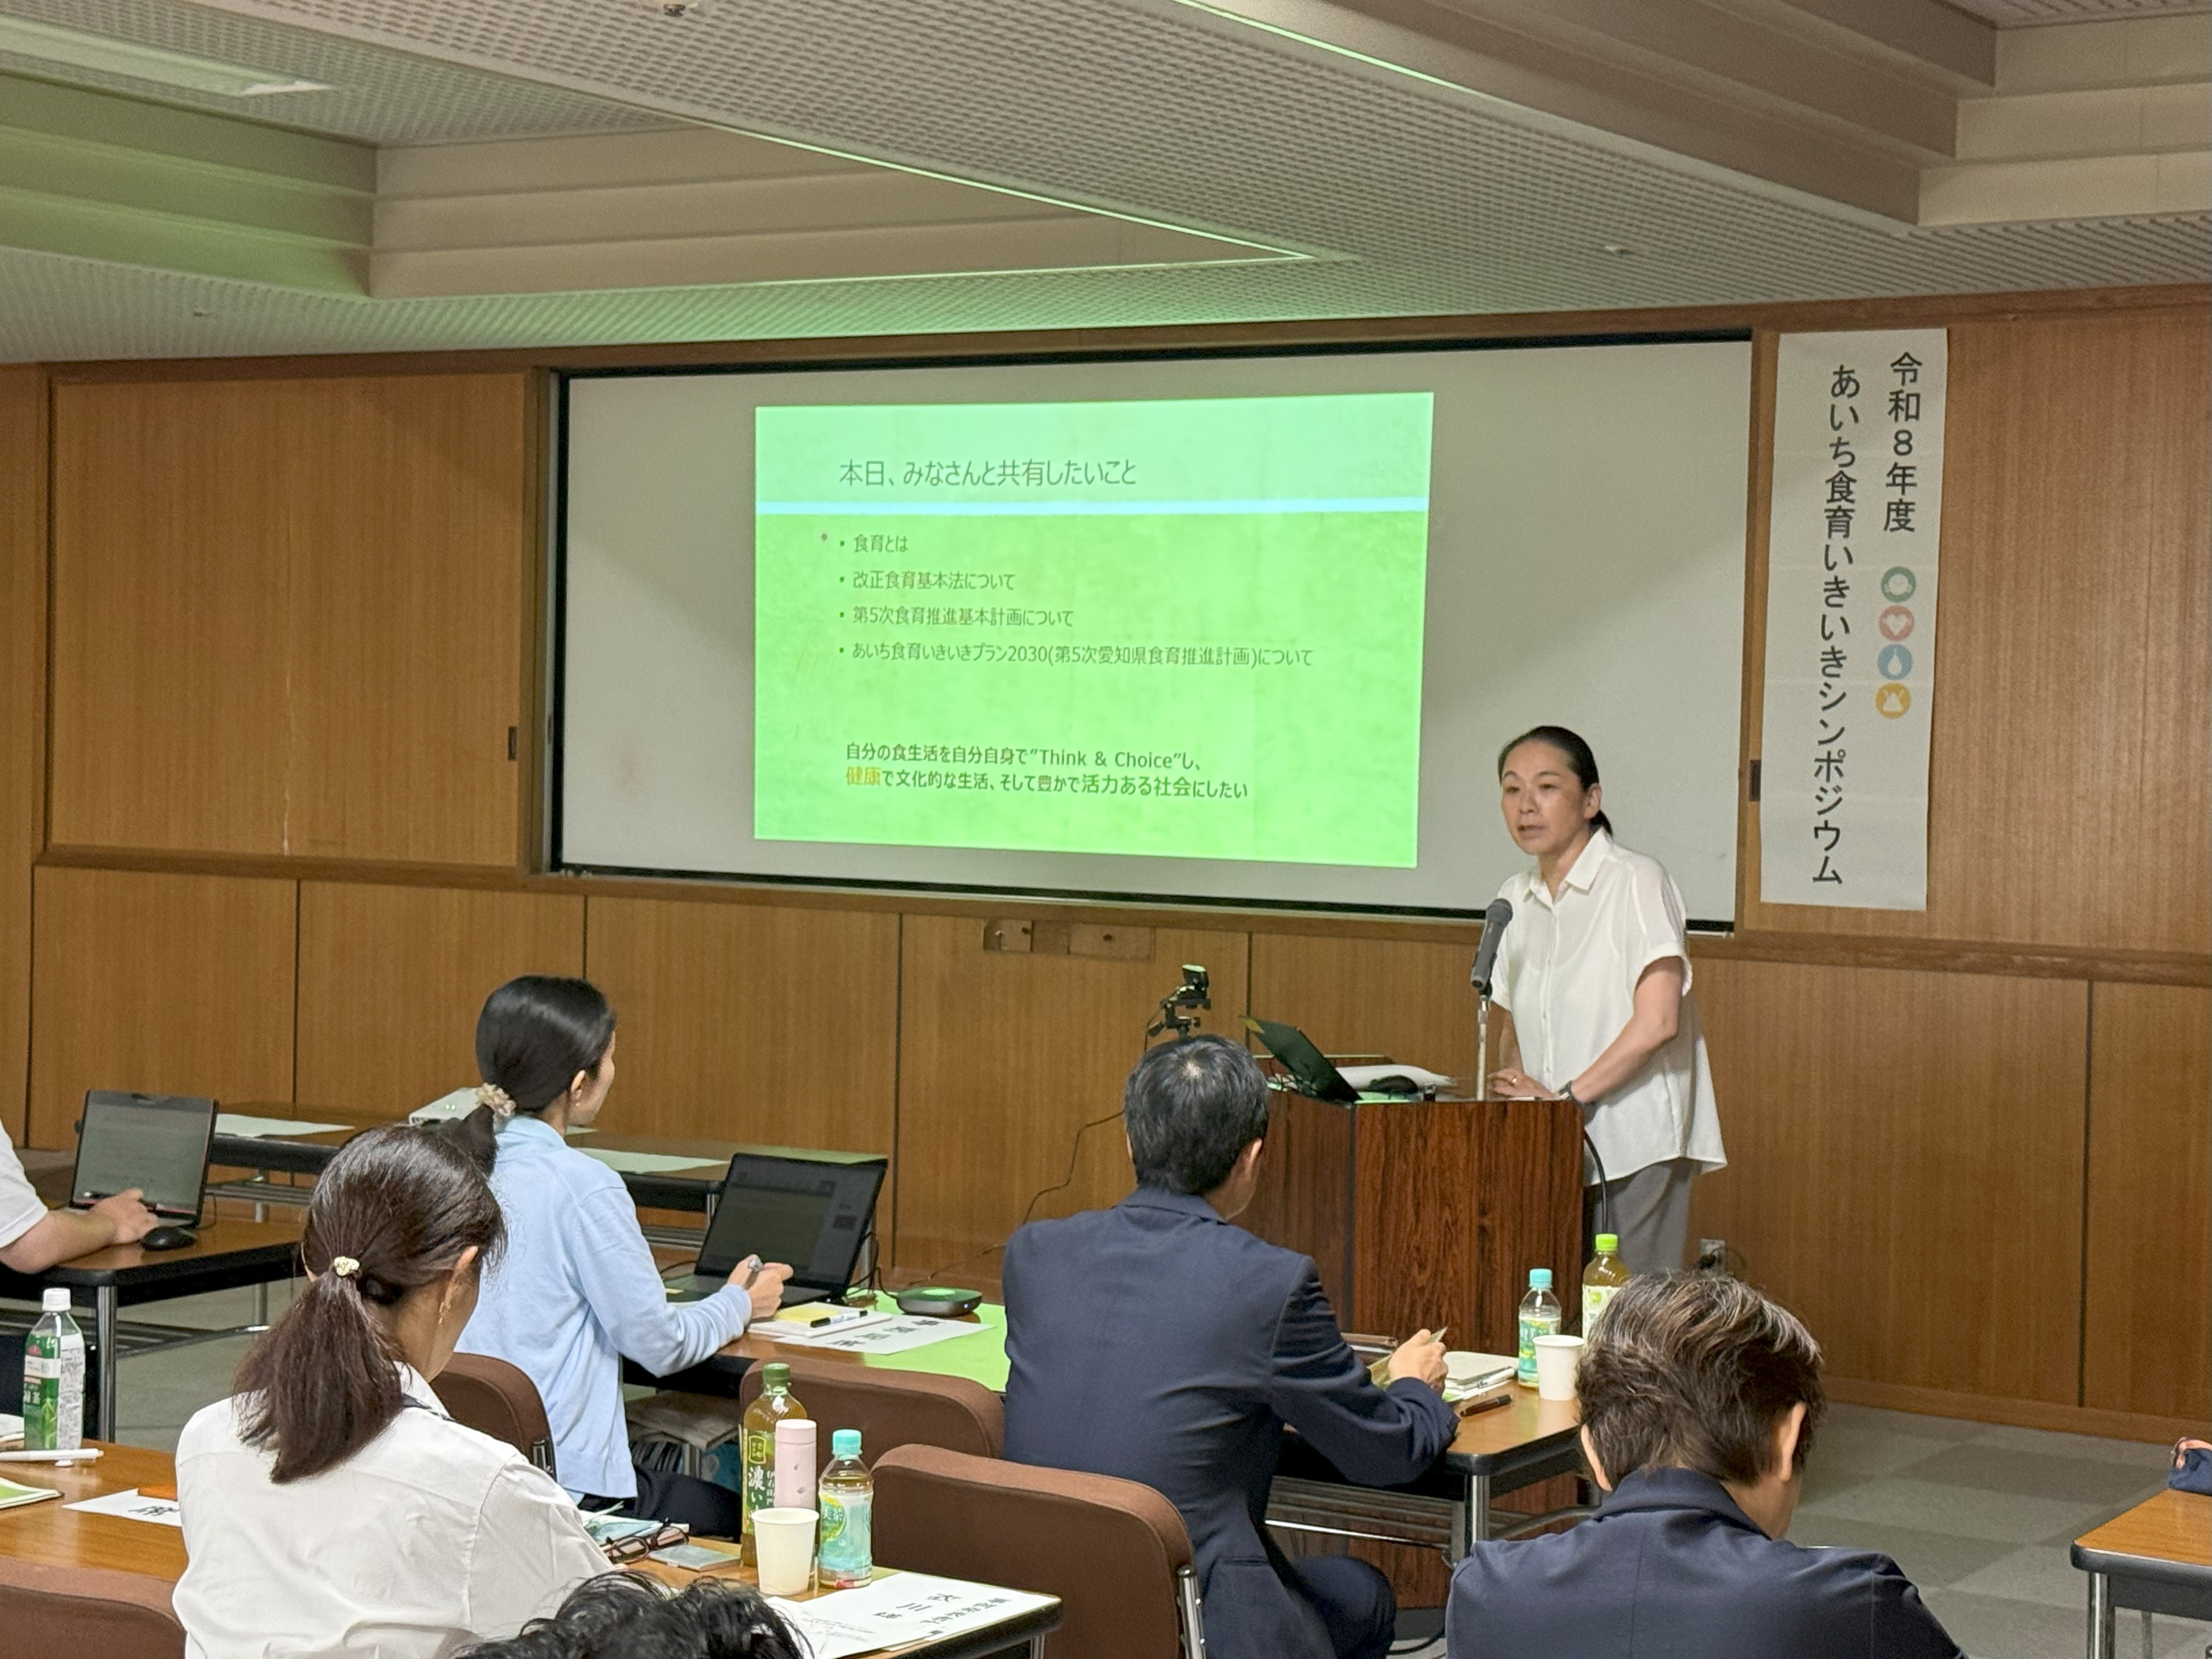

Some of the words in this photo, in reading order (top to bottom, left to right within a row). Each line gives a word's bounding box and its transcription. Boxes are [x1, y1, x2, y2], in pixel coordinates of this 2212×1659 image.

[1883, 351, 1923, 533] 令和8年度
[839, 458, 1137, 487] 本日、みなさんと共有したいこと
[854, 533, 909, 554] 食育とは
[853, 570, 1016, 591] 改正食育基本法について
[853, 605, 1074, 627] 第5次食育推進基本計画について
[1812, 364, 1860, 885] あいち食育いきいきシンポジウム
[852, 641, 1314, 668] あいち食育いきいきプラン2030(第5次愛知県食育推進計画)について
[1094, 751, 1107, 767] &
[845, 766, 1248, 799] 健康で文化的な生活、そして豊かで活力ある社会にしたい
